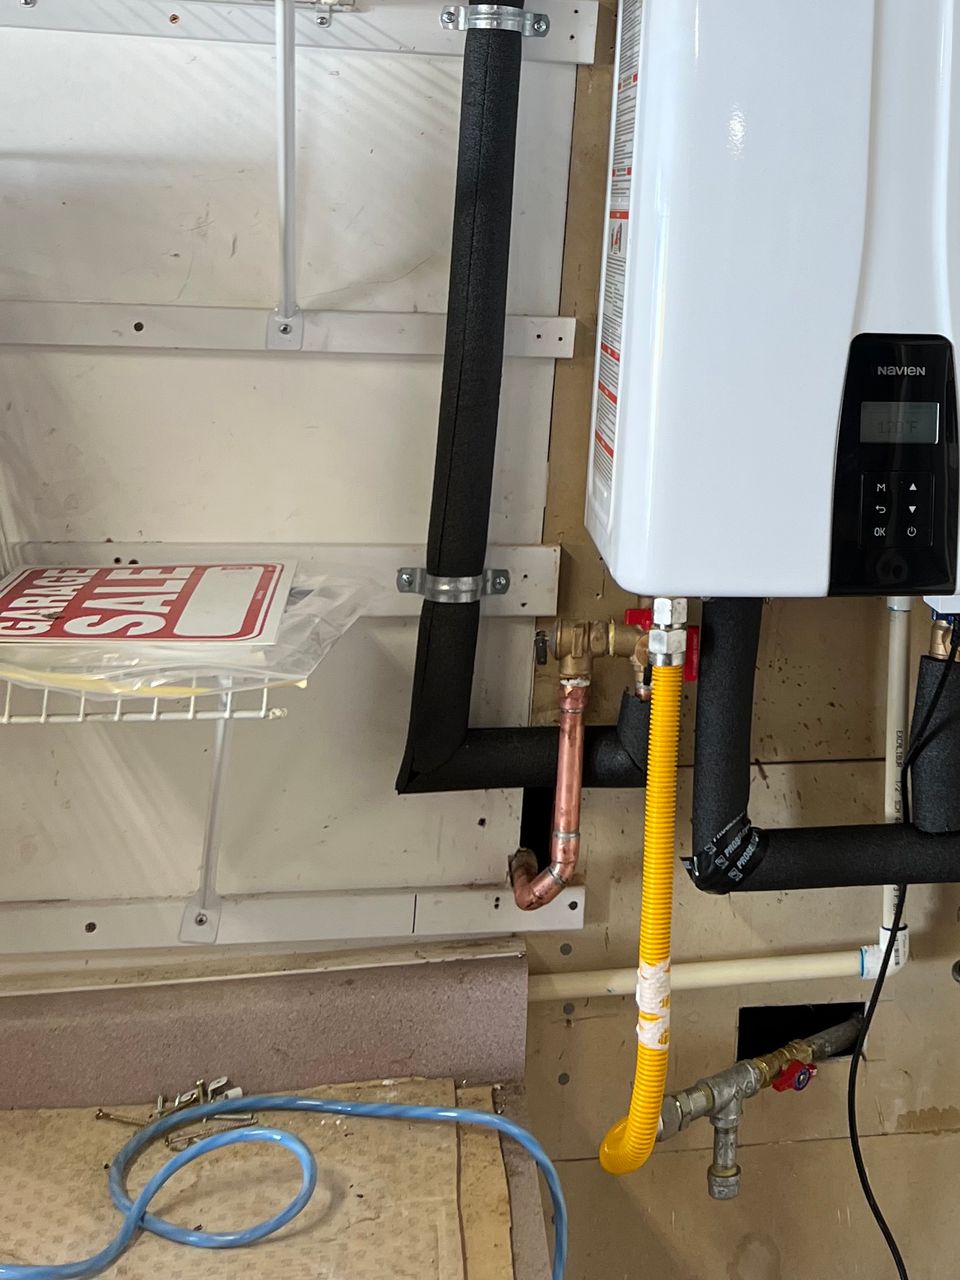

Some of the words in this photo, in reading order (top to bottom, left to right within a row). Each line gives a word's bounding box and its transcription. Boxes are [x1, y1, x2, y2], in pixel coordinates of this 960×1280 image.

[877, 483, 886, 492] M
[873, 527, 886, 537] OK
[0, 568, 92, 636] GARAGE
[63, 566, 197, 637] SALE
